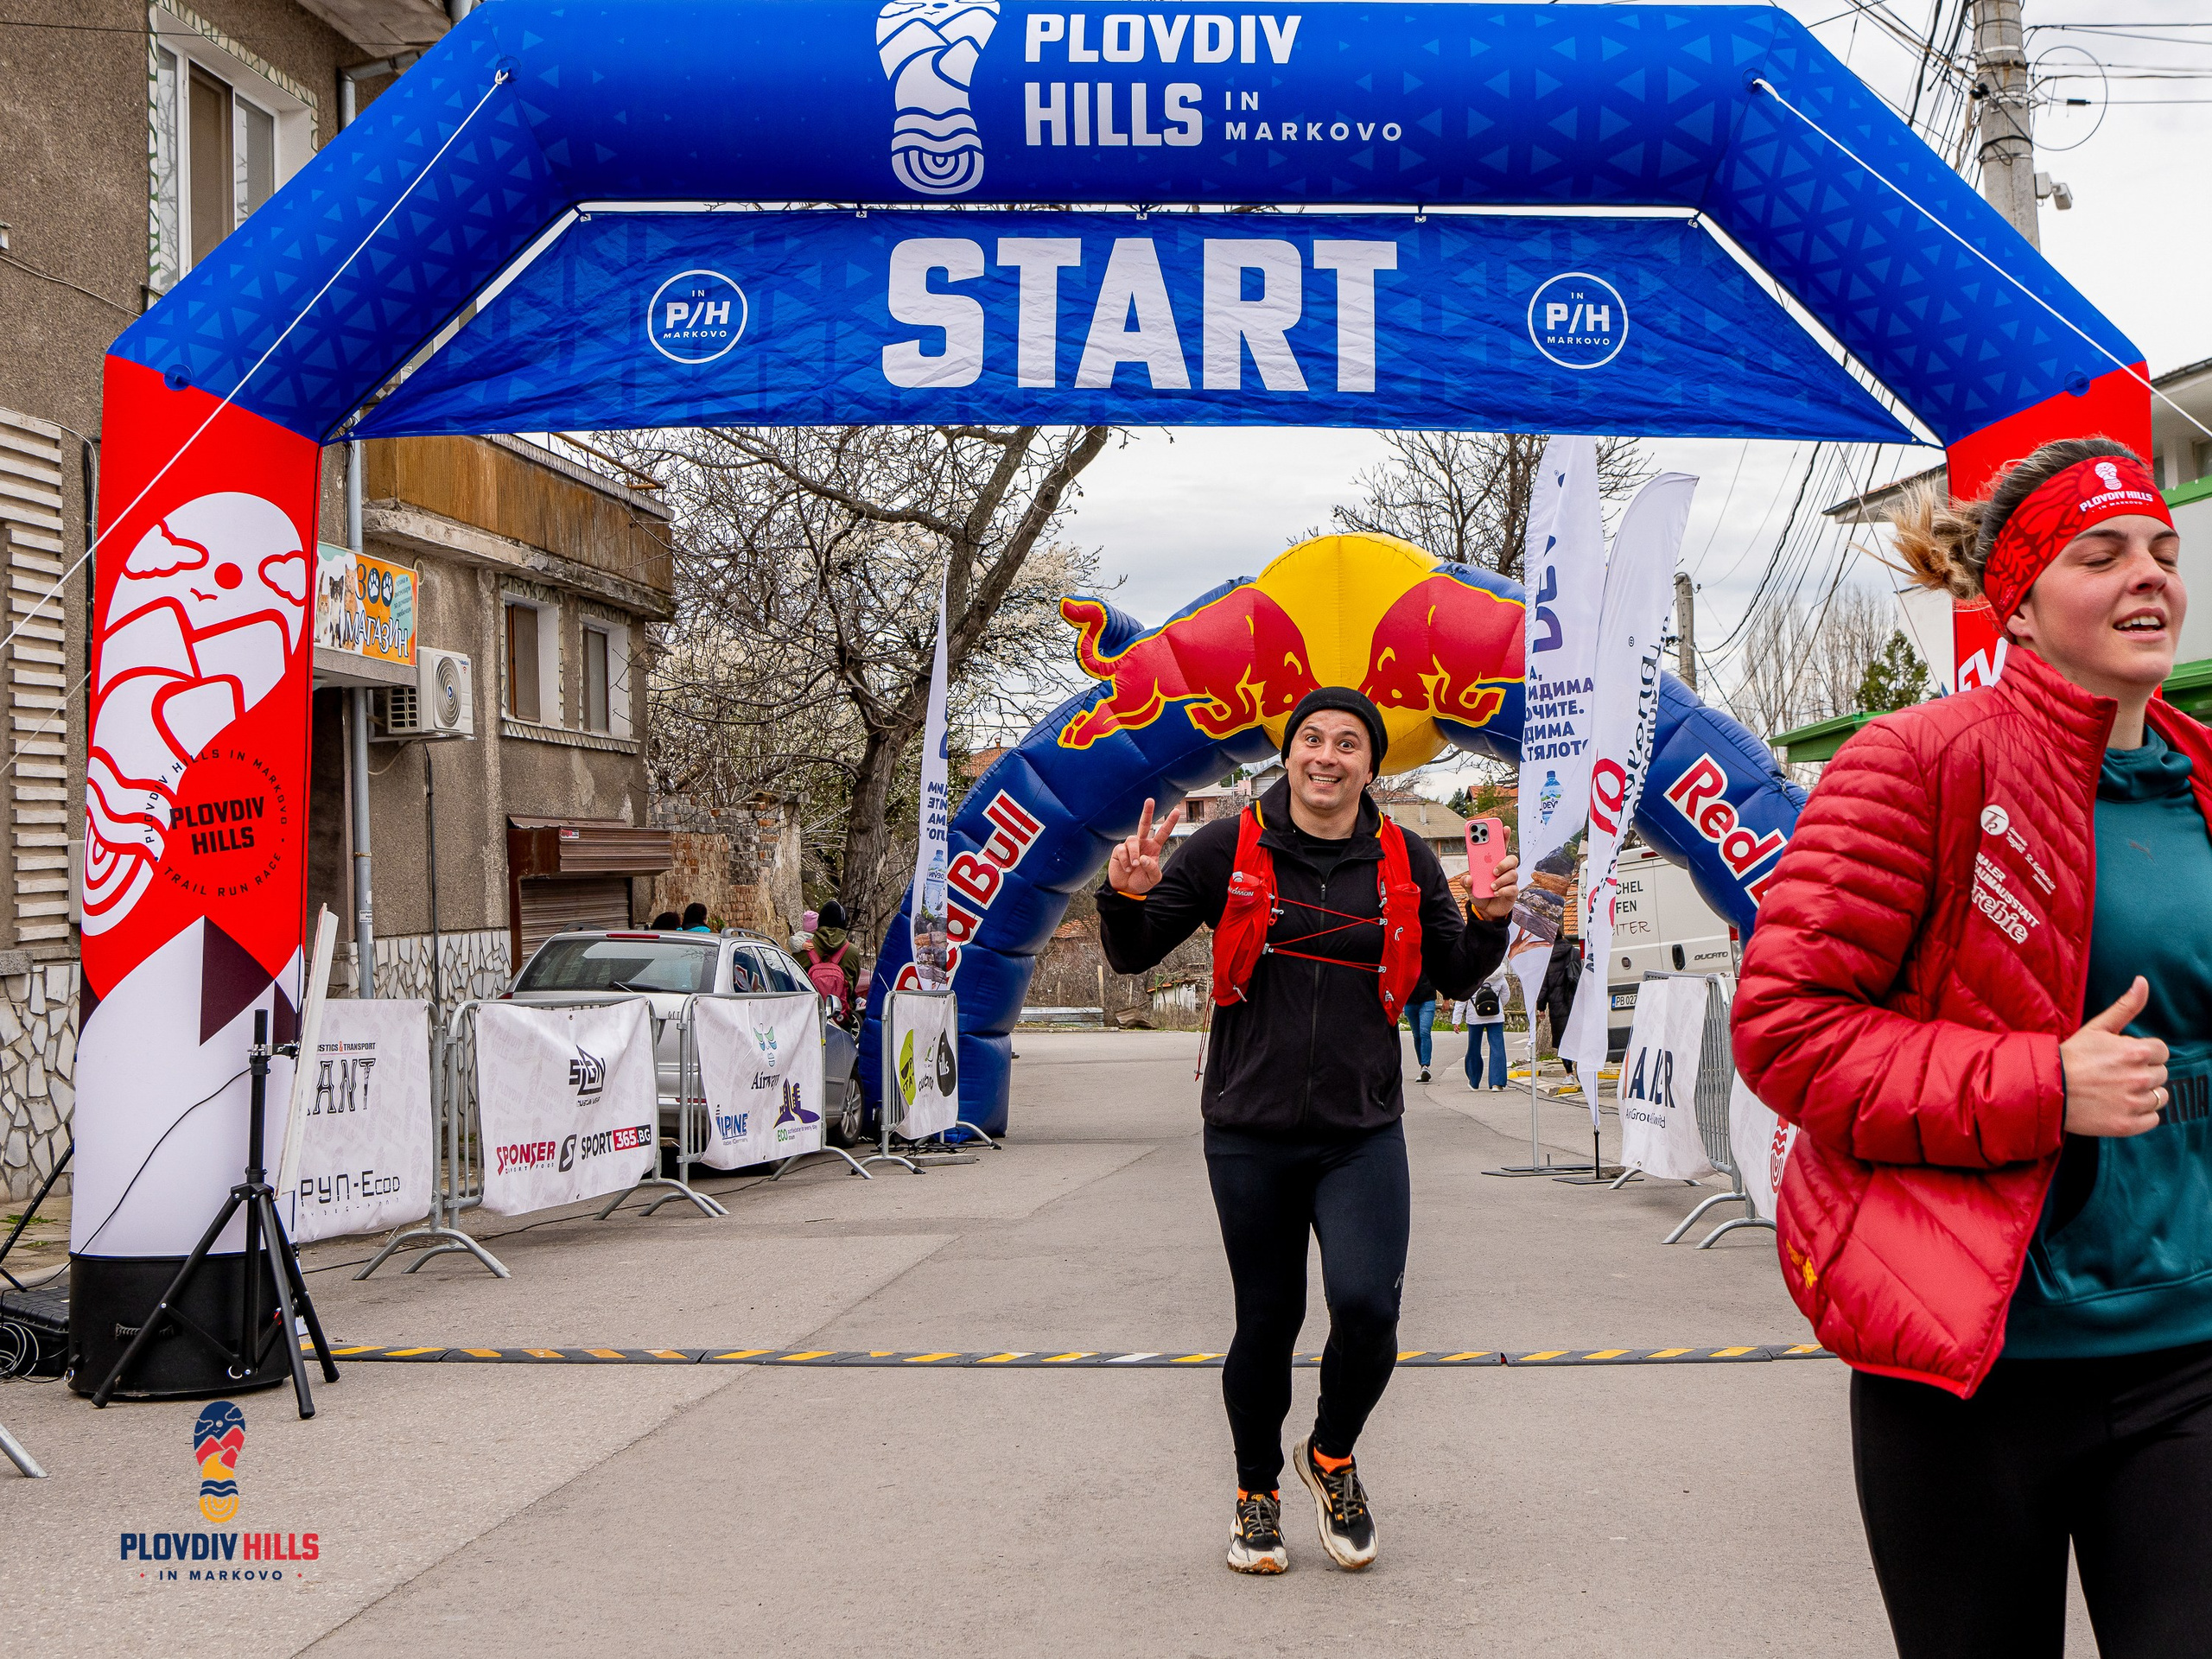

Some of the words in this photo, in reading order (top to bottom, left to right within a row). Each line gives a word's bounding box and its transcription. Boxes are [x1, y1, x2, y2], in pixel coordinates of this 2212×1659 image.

[1025, 14, 1302, 64] PLOVDIV
[1025, 82, 1203, 147] HILLS
[1225, 91, 1258, 111] IN
[1225, 122, 1402, 142] MARKOVO
[665, 301, 730, 329] P/H
[882, 238, 1397, 393] START
[1546, 302, 1610, 334] P/H
[663, 330, 727, 339] MARKOVO
[1547, 336, 1610, 346] MARKOVO
[2079, 491, 2126, 512] PLOVDIV
[2127, 491, 2153, 502] HILLS
[345, 610, 409, 658] МАГАЗИН
[144, 776, 168, 843] PLOVDIV
[172, 749, 219, 773] HILLS
[230, 749, 245, 761] IN
[252, 759, 287, 824] MARKOVO
[169, 797, 264, 830] PLOVDIV
[1668, 758, 1783, 875] Red
[191, 826, 255, 855] HILLS
[948, 794, 1041, 906] Bull
[164, 867, 207, 896] TRAIL
[218, 883, 249, 897] RUN
[254, 853, 281, 885] RACE
[1616, 900, 1637, 913] FEN
[1971, 874, 2029, 944] rebie
[1694, 951, 1729, 961] DUCATO
[307, 1058, 376, 1116] ANT
[496, 1141, 556, 1176] SPONSER
